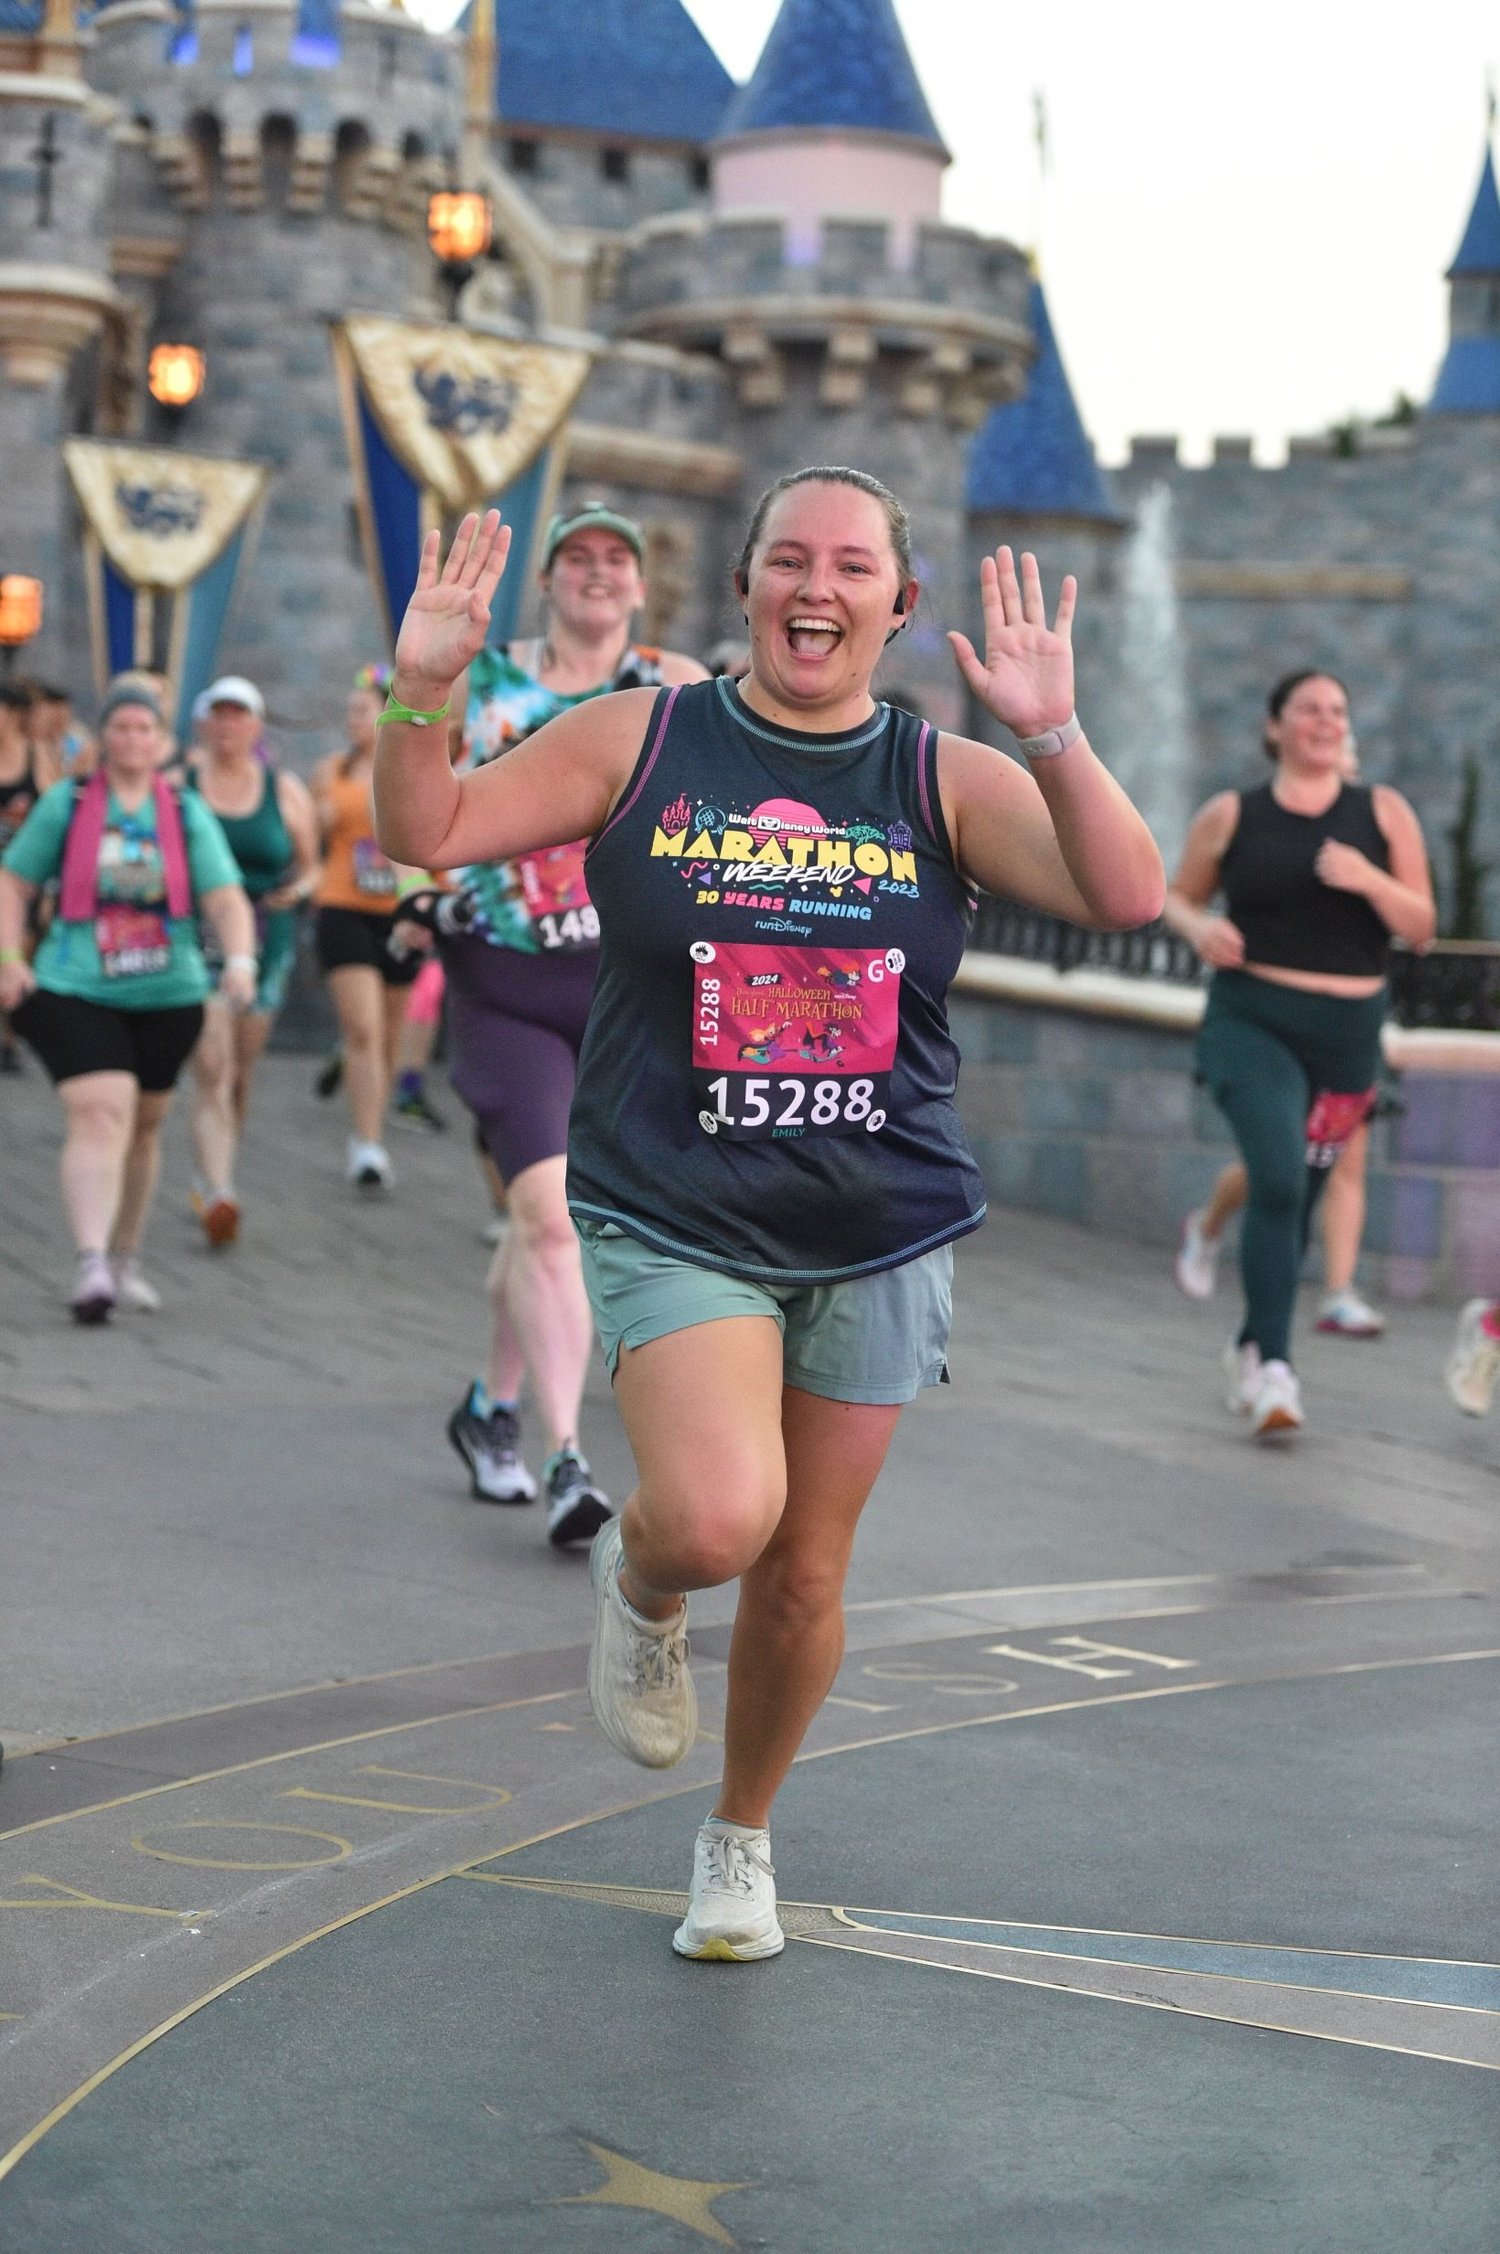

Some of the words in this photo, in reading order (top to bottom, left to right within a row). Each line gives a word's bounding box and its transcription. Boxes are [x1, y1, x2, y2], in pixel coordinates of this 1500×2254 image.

[728, 813, 759, 827] Walt
[757, 816, 811, 835] Disney
[812, 824, 846, 836] World
[650, 825, 917, 885] MARATHON
[722, 860, 856, 884] WEEKEND
[878, 880, 920, 898] 2023
[696, 890, 719, 904] 30
[723, 891, 785, 911] YEARS
[789, 899, 872, 921] RUNNING
[751, 974, 779, 986] 2024
[868, 959, 884, 983] G
[768, 986, 831, 1001] HALLOWEEN
[699, 978, 720, 1046] 15288
[731, 997, 774, 1018] HALF
[776, 1001, 863, 1020] MARATHON
[707, 1077, 874, 1127] 15288
[772, 1128, 806, 1138] EMILY
